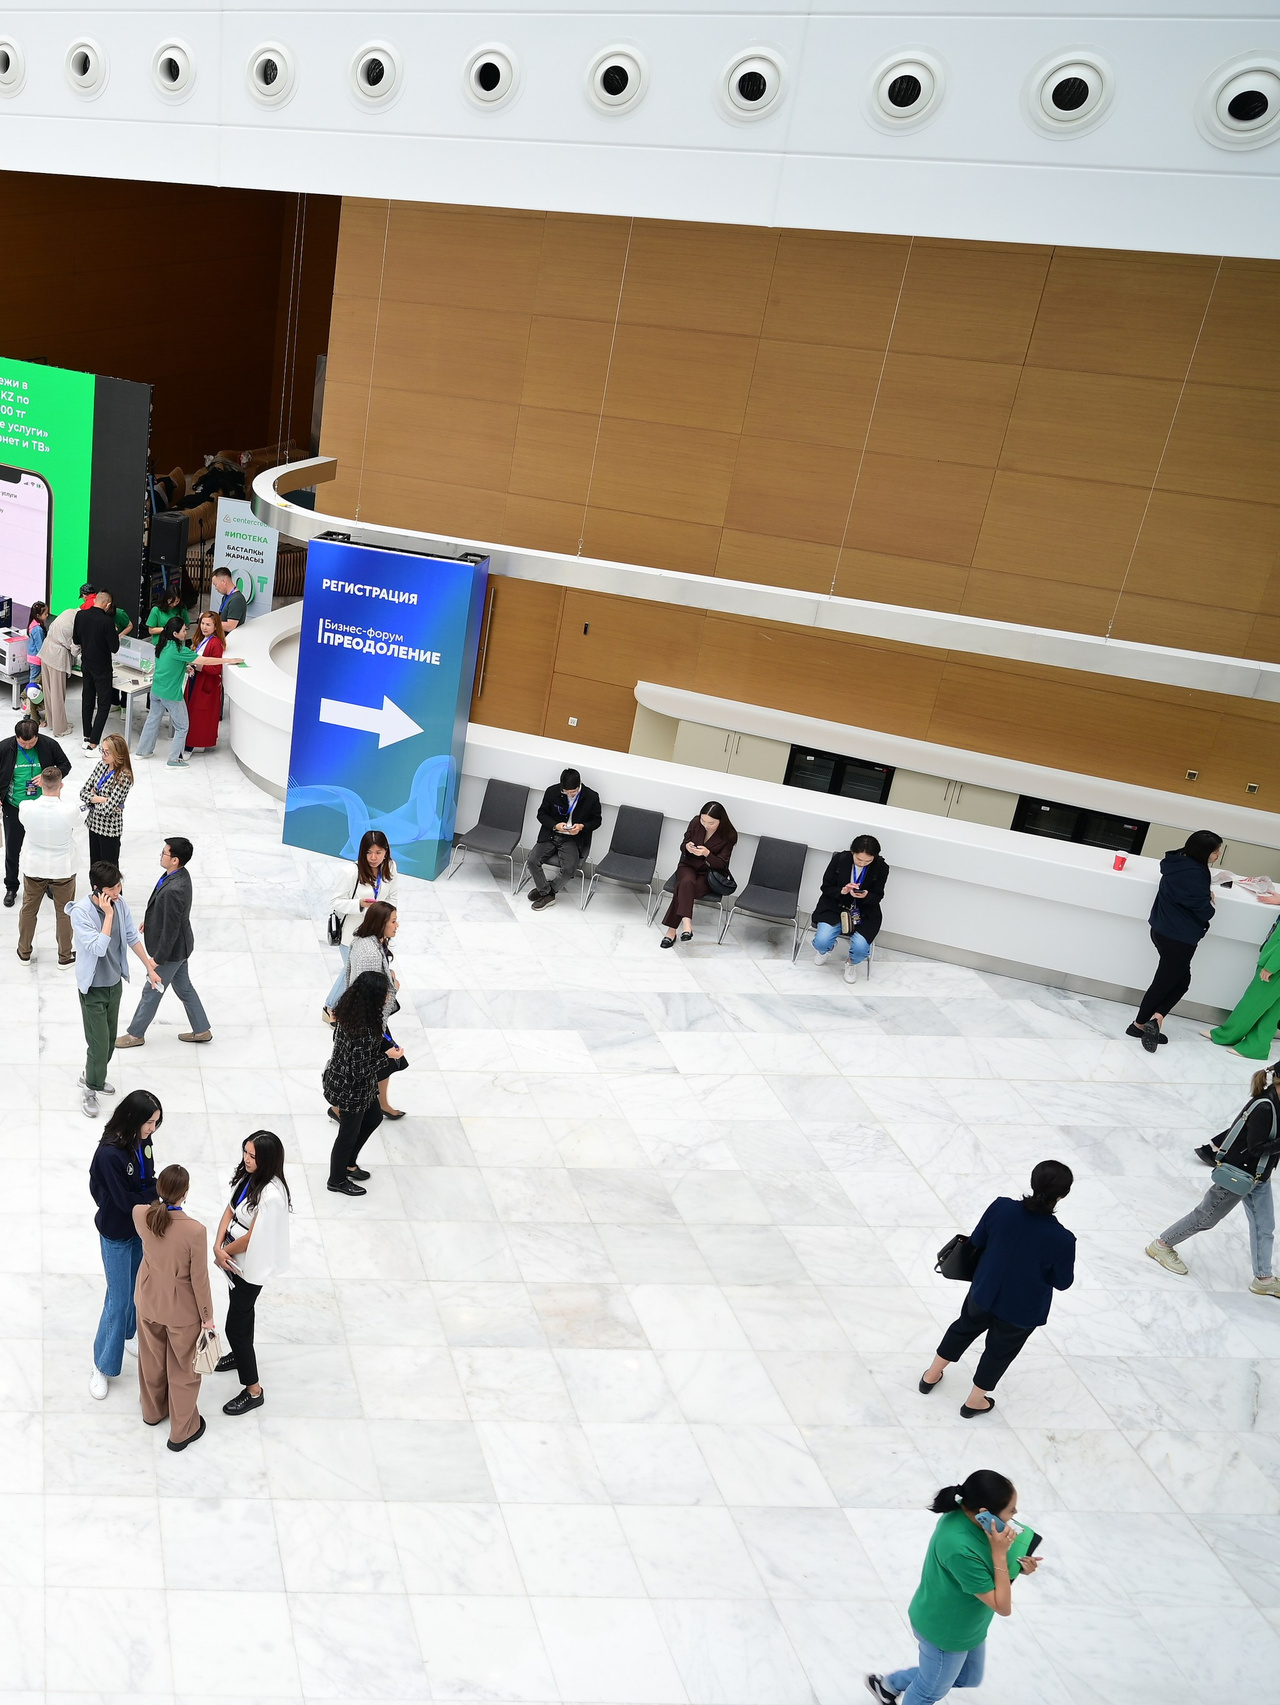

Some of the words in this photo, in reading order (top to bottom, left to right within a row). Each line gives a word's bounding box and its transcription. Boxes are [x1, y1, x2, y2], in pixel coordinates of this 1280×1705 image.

[22, 382, 28, 390] в
[17, 396, 30, 405] по
[15, 410, 26, 418] тг
[8, 422, 49, 438] услуги»
[22, 440, 29, 448] и
[31, 440, 50, 452] ТВ»
[1, 490, 18, 499] услуги
[232, 516, 271, 528] centercre
[224, 530, 269, 545] #ИПОТЕКА
[226, 544, 264, 557] БАСТАПҚЫ
[225, 552, 265, 564] ЖАРНАСЫЗ
[322, 578, 418, 605] РЕГИСТРАЦИЯ
[324, 619, 404, 642] Бизнес-форум
[323, 631, 441, 665] ПРЕОДОЛЕНИЕ
